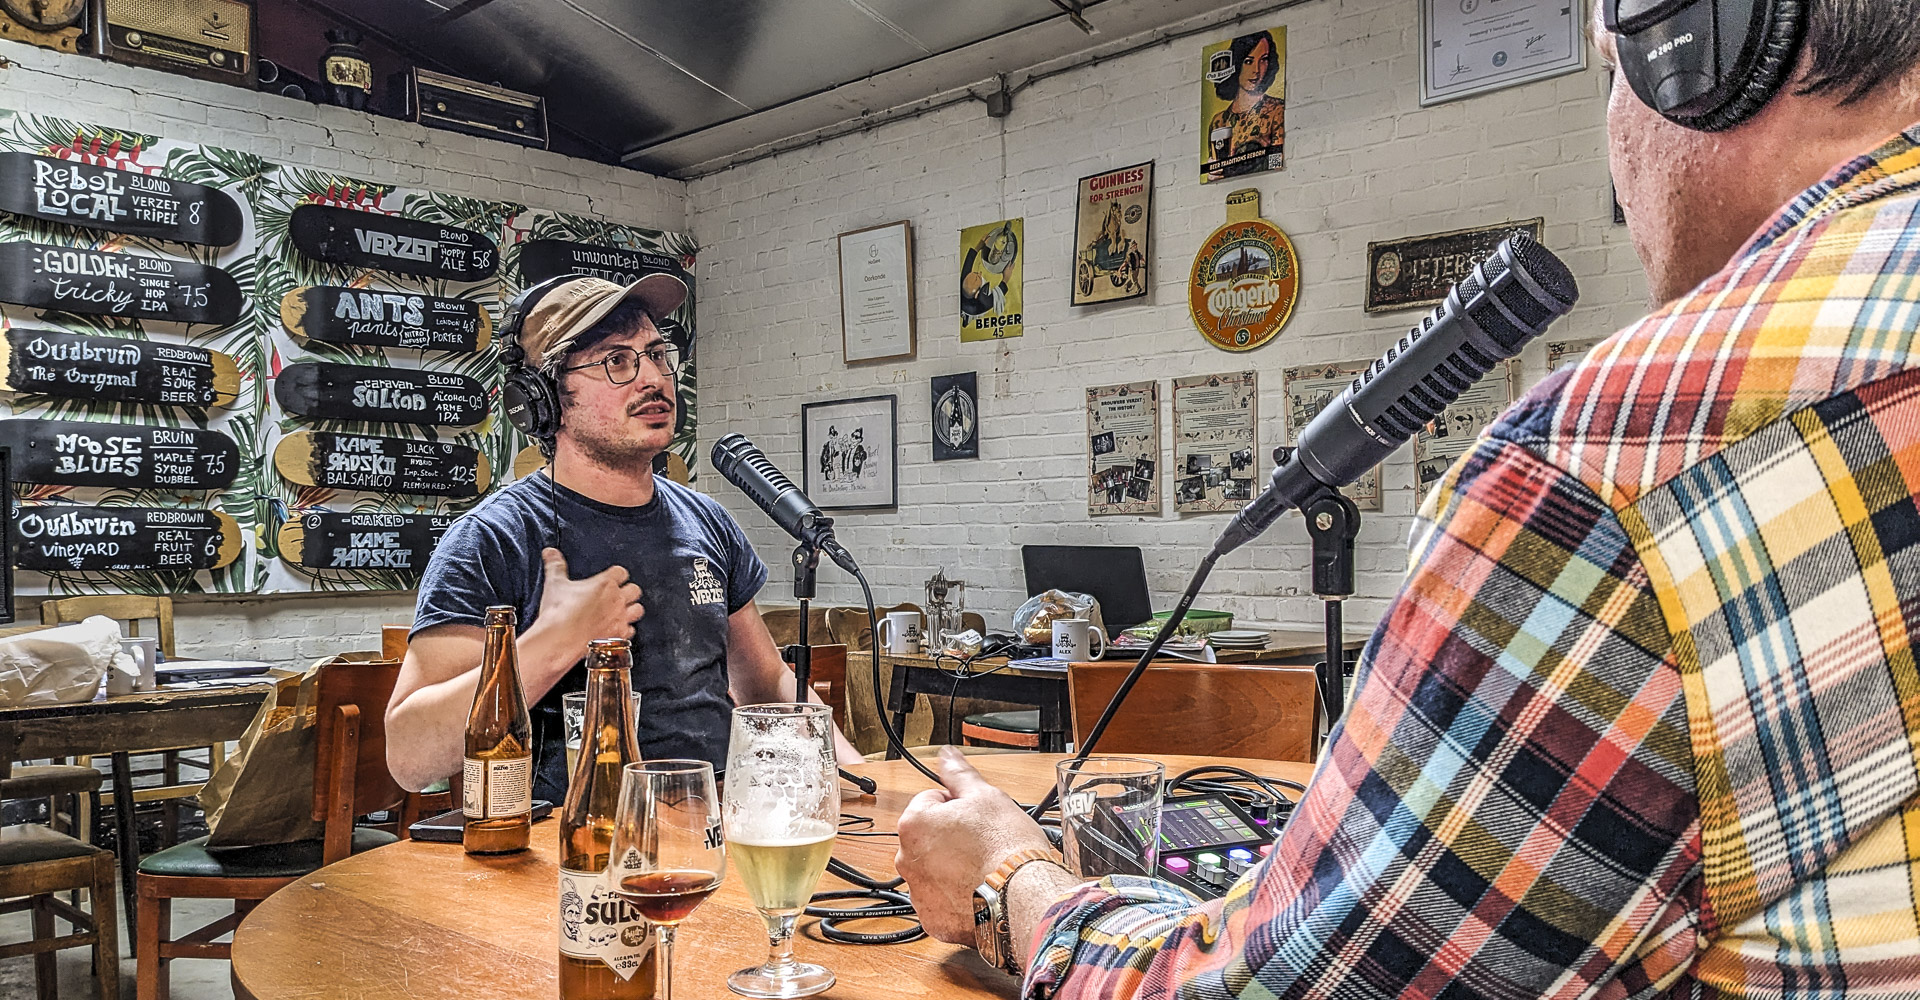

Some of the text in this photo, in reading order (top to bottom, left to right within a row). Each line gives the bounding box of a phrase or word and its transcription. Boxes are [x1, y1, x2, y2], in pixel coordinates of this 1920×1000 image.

[1647, 32, 1693, 62] HD 280 PRO
[1210, 149, 1266, 170] BEER TRADITIONS REBORN
[132, 176, 171, 193] BLOND
[1090, 168, 1144, 191] GUINNESS
[1090, 184, 1144, 203] FOR STRENGTH
[35, 187, 128, 221] LOCAL
[132, 196, 181, 211] VERZET
[440, 229, 469, 242] BLOND
[354, 228, 439, 263] VERZET
[440, 246, 466, 260] HOPPY
[572, 249, 670, 270] unwanted BLOND
[43, 250, 129, 278] GOLDEN
[139, 259, 172, 273] BLOND
[441, 259, 467, 272] ALE
[140, 278, 170, 288] SINGLE
[49, 277, 135, 313] tricky
[145, 289, 166, 298] HOP
[1202, 279, 1280, 318] Tongerlo
[140, 300, 169, 312] IPA
[335, 292, 425, 326] ANTS
[434, 301, 466, 311] BROWN
[435, 318, 460, 327] LONDON
[976, 313, 1022, 329] BERGER
[1217, 306, 1269, 331] Christmas
[1254, 296, 1291, 341] Double Blonde
[347, 320, 399, 339] pants
[992, 327, 1004, 338] 45
[1196, 309, 1231, 344] Dubbel Blond
[404, 330, 424, 338] NITRO
[432, 332, 464, 344] PORTER
[26, 337, 142, 366] Oudbruin
[162, 365, 196, 378] REAL
[27, 365, 139, 392] The Original
[162, 378, 197, 391] SOUR
[363, 379, 415, 390] caravan
[428, 374, 464, 386] BLOND
[161, 391, 197, 403] BEER
[432, 391, 469, 403] ALCOHOL
[434, 403, 464, 413] ARME
[439, 412, 461, 422] IPA
[55, 433, 142, 456] MOOSE
[335, 436, 384, 455] KAME
[406, 443, 435, 455] BLACK
[153, 451, 195, 463] MAPLE
[410, 458, 433, 467] HYBRID
[55, 454, 142, 477] BLUES
[154, 463, 193, 475] SYRUP
[154, 475, 199, 484] DUBBEL
[420, 469, 439, 477] Stout
[327, 472, 392, 488] BALSAMICO
[403, 481, 431, 490] FLEMISH
[147, 511, 204, 524] REDBROWN
[351, 514, 405, 527] NAKED
[19, 511, 137, 538] Oudbruin
[157, 530, 194, 541] REAL
[350, 532, 400, 548] KAME
[153, 541, 194, 553] FRUIT
[158, 553, 193, 565] BEER
